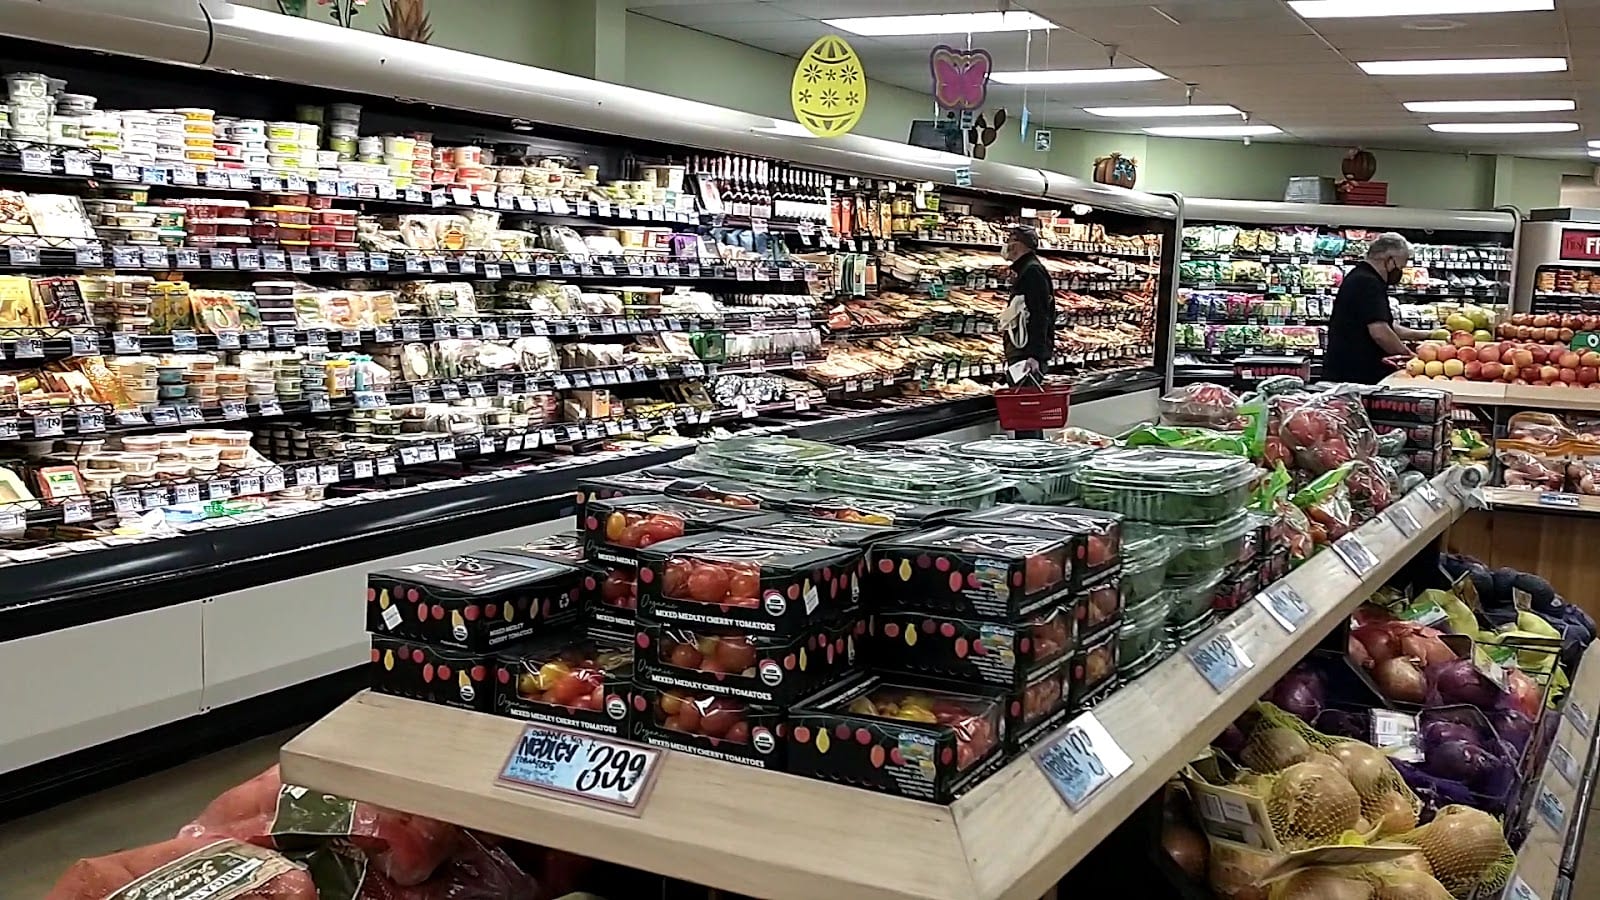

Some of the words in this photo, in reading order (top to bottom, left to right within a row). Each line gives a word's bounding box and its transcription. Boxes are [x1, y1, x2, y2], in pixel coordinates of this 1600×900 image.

[615, 617, 636, 627] MEDLE
[655, 609, 678, 620] MIXED
[678, 612, 706, 623] MEDLEY
[706, 615, 734, 627] CHERRY
[734, 619, 776, 632] TOMATOES
[651, 674, 674, 685] MIXED
[674, 678, 702, 690] MEDLEY
[702, 683, 730, 695] CHERRY
[730, 687, 773, 701] TOMATOES
[510, 708, 531, 718] MIXED
[531, 711, 556, 723] MEDLEY
[556, 716, 580, 727] CHERRY
[580, 720, 618, 734] TOMATOES
[648, 737, 670, 748] MIXED
[670, 741, 697, 754] MEDLEY
[697, 747, 725, 760] CHERRY
[725, 753, 765, 768] TOMATOES
